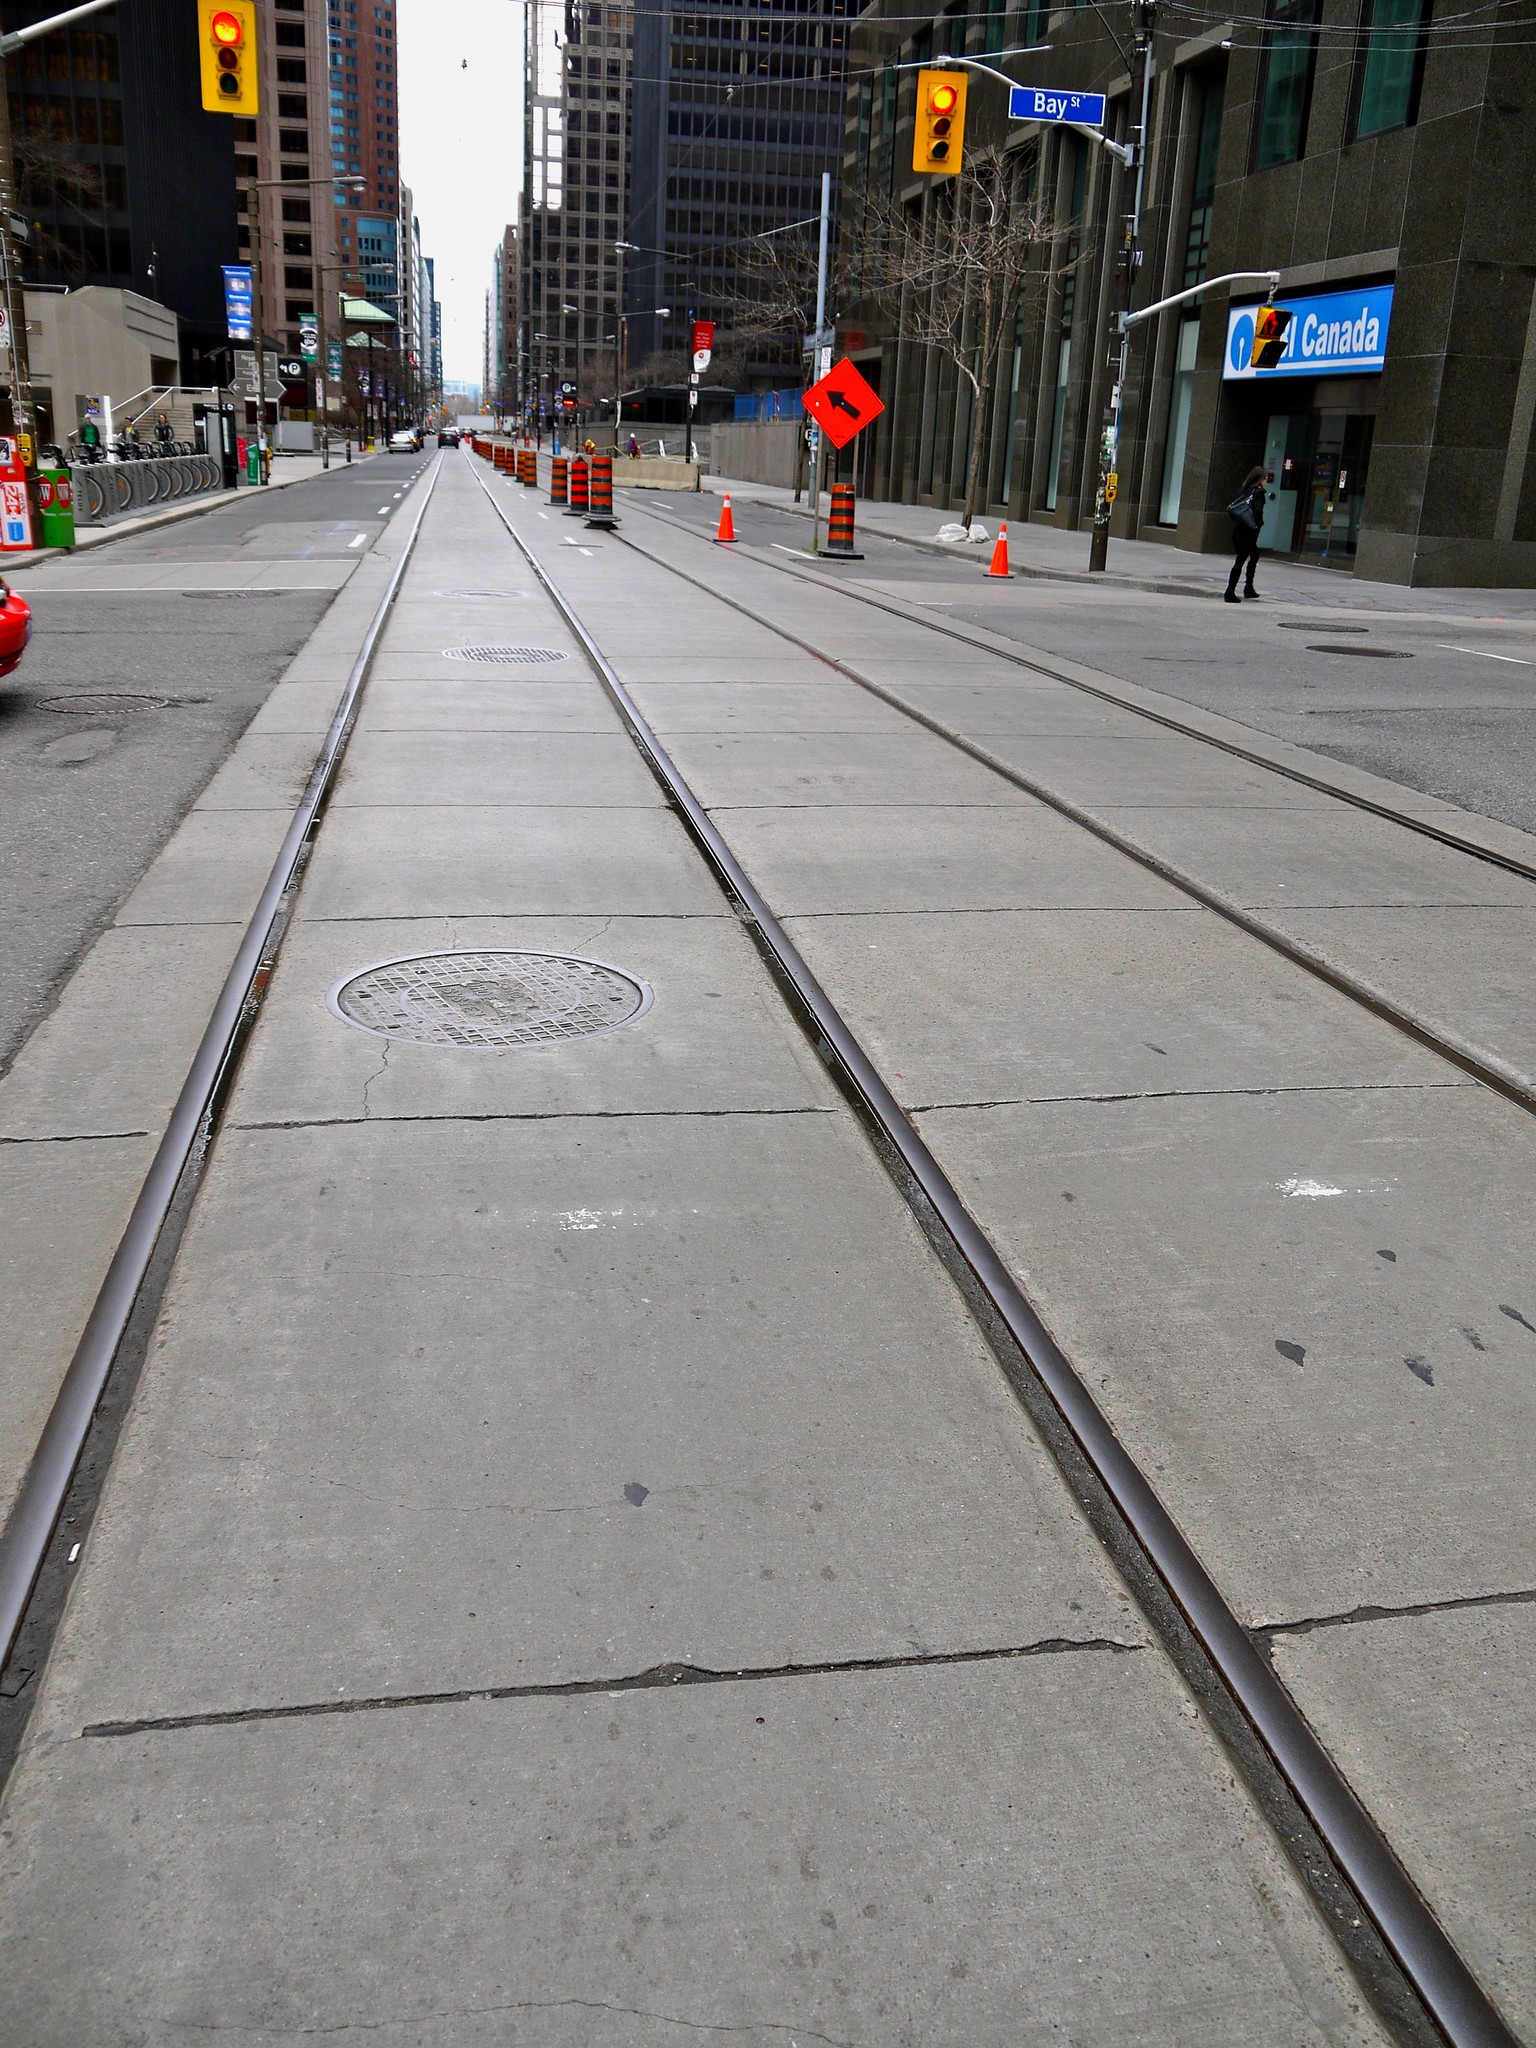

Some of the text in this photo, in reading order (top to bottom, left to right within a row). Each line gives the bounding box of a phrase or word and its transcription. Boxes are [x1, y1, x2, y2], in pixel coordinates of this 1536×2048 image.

[1034, 92, 1081, 119] Bay St
[1301, 307, 1380, 358] Canada
